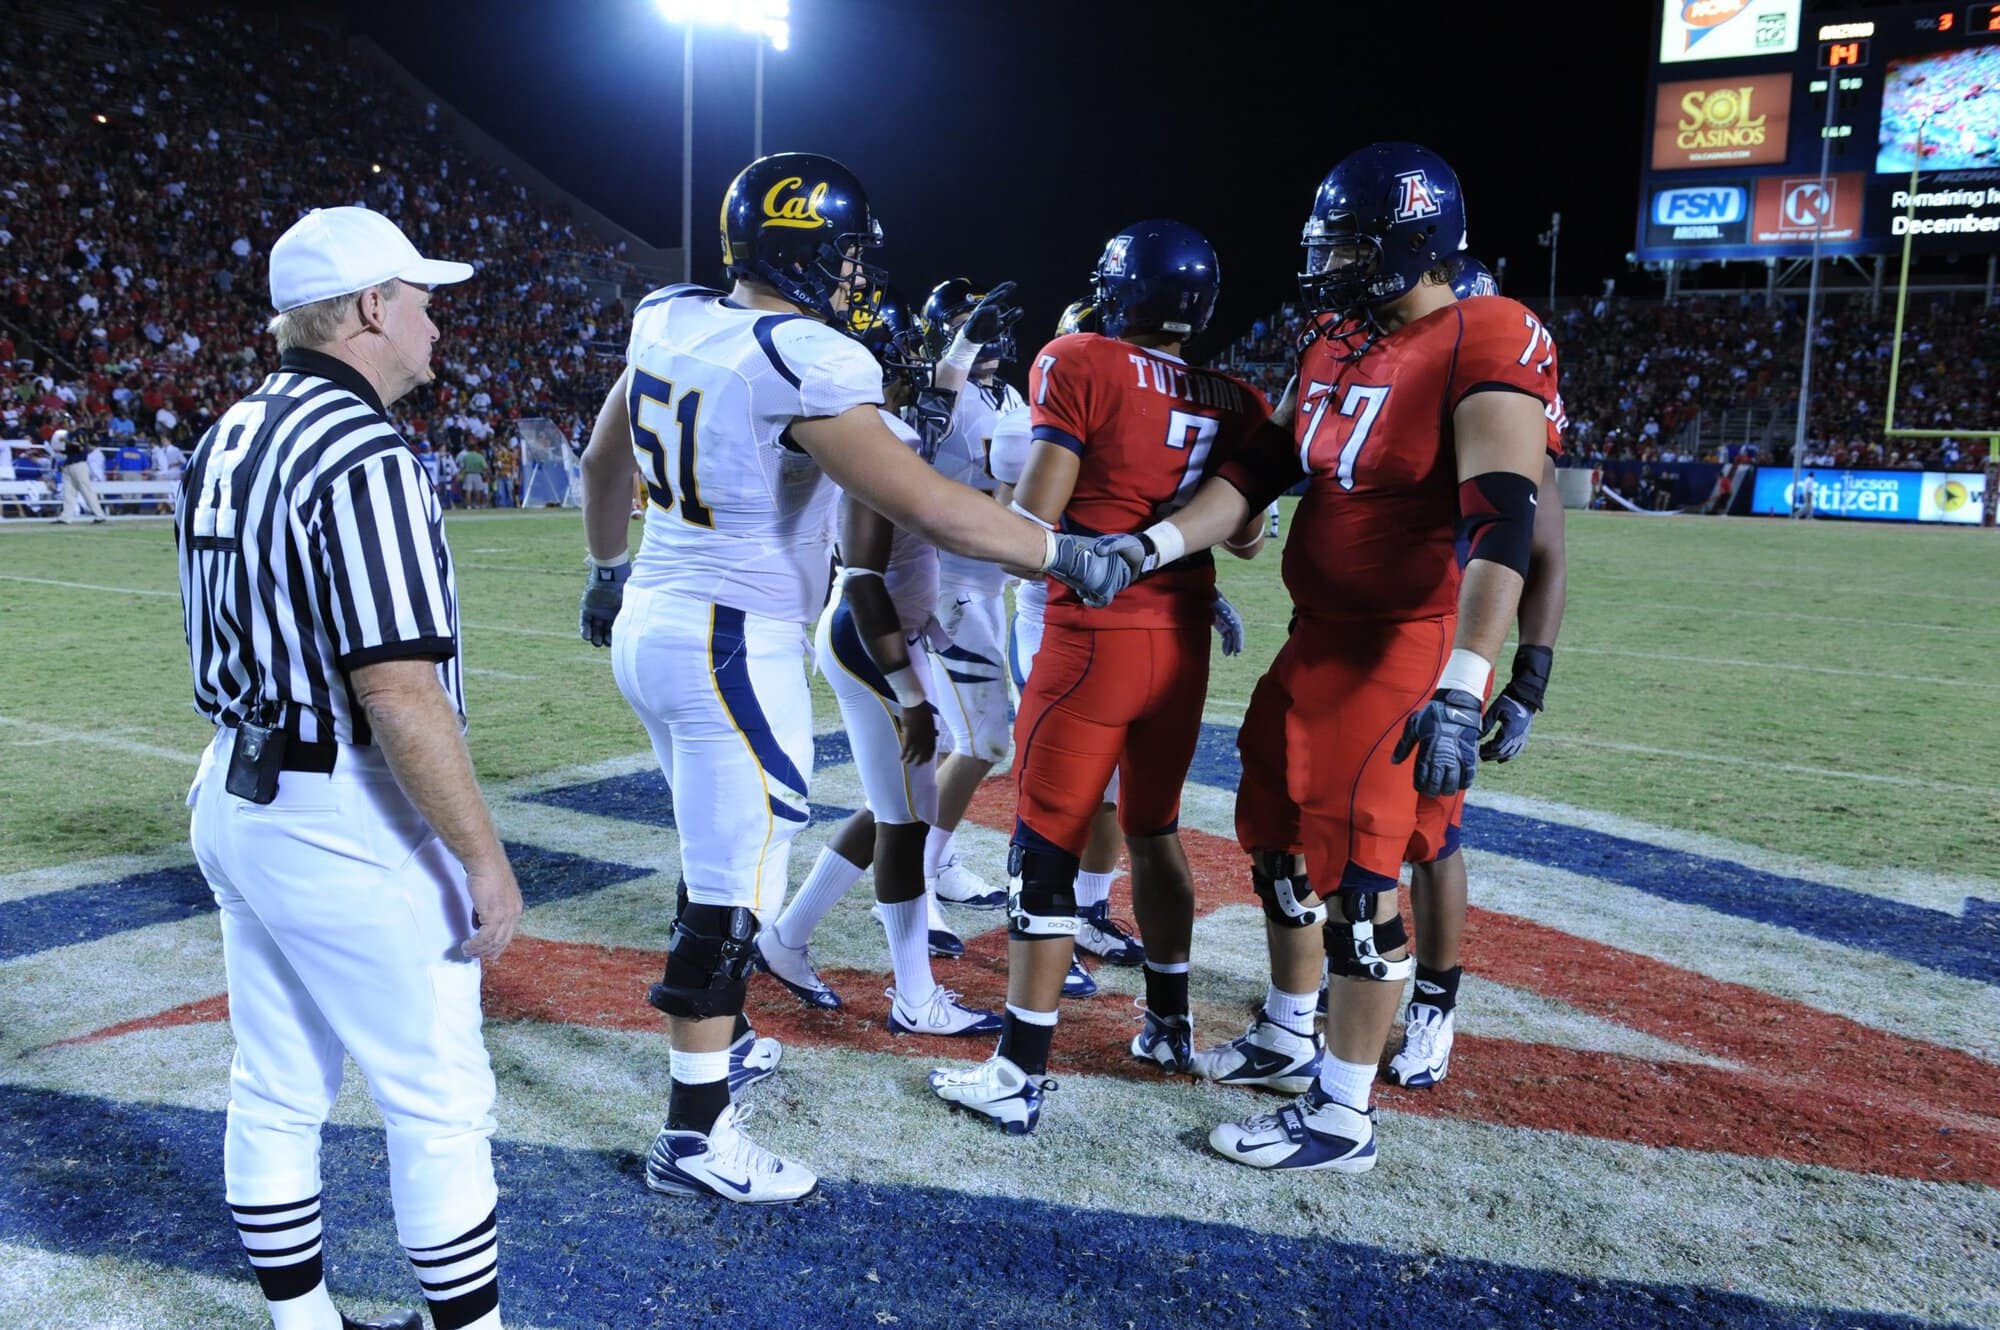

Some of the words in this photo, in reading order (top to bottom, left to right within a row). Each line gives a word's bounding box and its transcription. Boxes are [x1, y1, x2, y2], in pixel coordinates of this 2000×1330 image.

[1938, 12, 1953, 31] 3
[1678, 87, 1767, 131] SOL
[1676, 127, 1766, 149] CASINOS
[761, 177, 830, 229] Cal
[1394, 169, 1441, 224] A
[1666, 192, 1731, 220] FSN
[1892, 213, 2000, 235] December
[1103, 235, 1134, 277] A
[1037, 354, 1057, 406] 7
[629, 365, 715, 530] 51
[1160, 408, 1220, 512] 7
[1301, 379, 1392, 493] 77
[193, 400, 266, 538] R
[1840, 475, 1899, 491] Tucson
